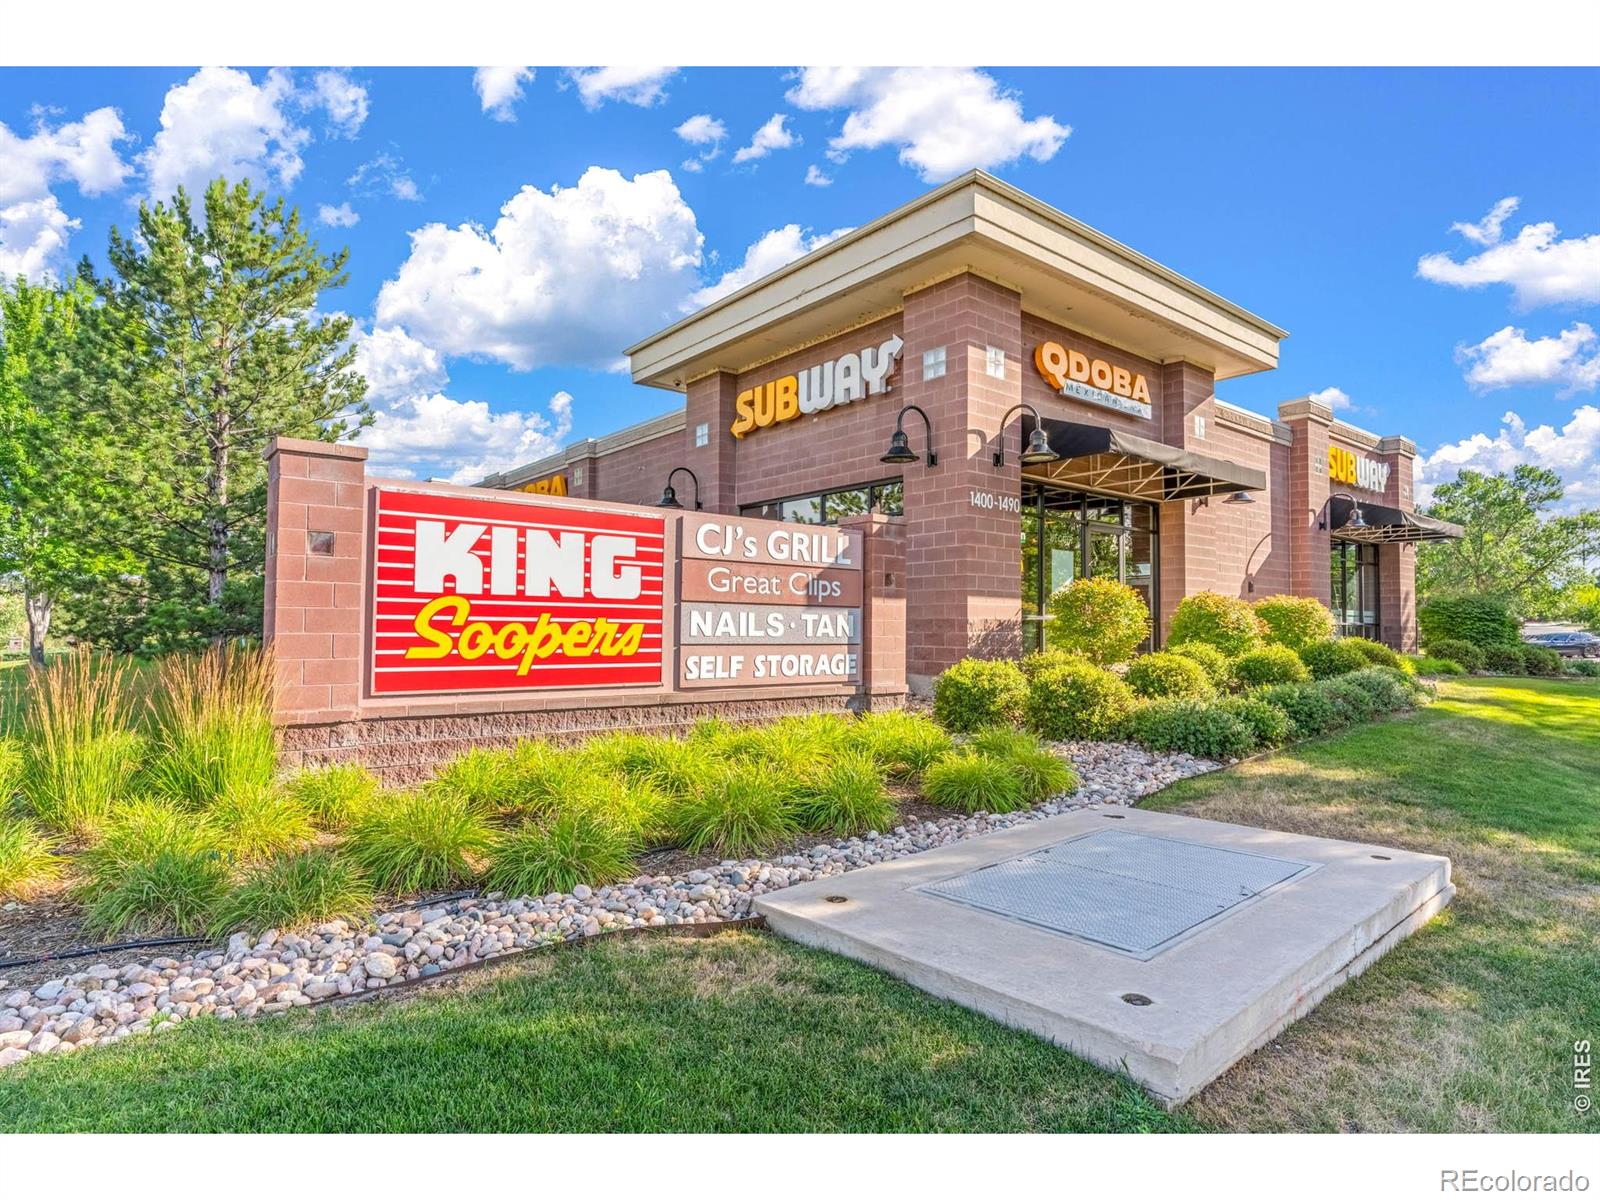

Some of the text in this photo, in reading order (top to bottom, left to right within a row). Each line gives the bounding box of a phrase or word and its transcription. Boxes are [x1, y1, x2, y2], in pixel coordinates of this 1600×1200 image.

[730, 333, 904, 439] SUBWAY
[1035, 341, 1151, 404] QDOBA
[1328, 445, 1391, 493] SUBWAY
[970, 491, 1020, 513] 1400-1490
[414, 520, 641, 599] KING
[696, 522, 852, 565] CJ's GRILL
[707, 566, 841, 602] Great Clips
[404, 595, 645, 676] Soopers
[689, 610, 854, 638] NAILS TAN
[685, 654, 857, 680] SELF STORAGE
